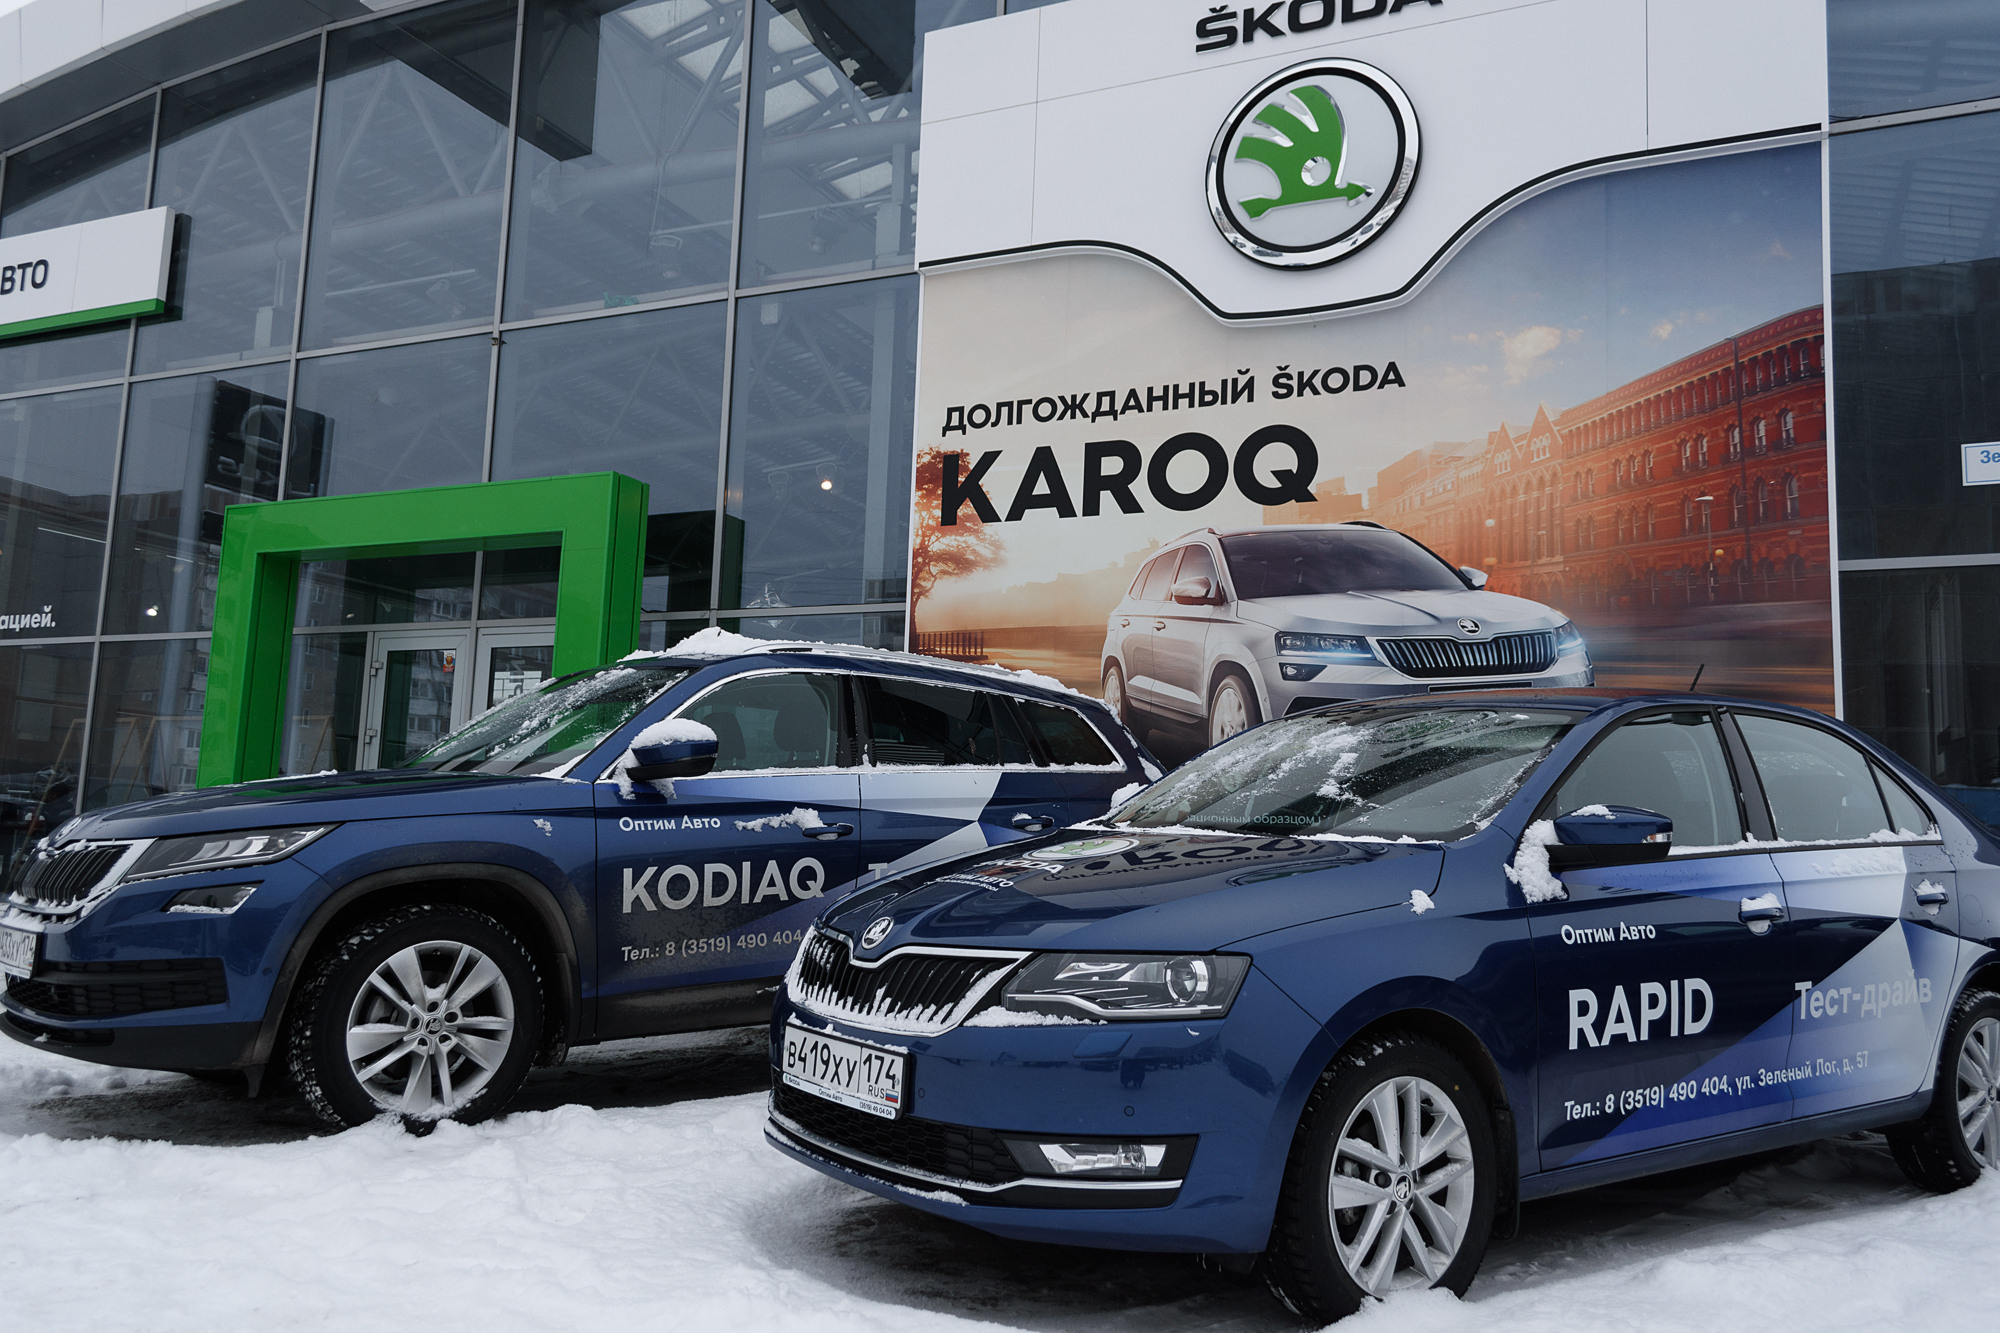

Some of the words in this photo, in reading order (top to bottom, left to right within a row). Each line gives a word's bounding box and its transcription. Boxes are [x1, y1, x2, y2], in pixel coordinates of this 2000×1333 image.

[941, 368, 1256, 437] ДОЛГОЖДАННЫЙ
[1271, 360, 1407, 400] ŠKODA
[940, 424, 1319, 527] KAROQ
[619, 816, 676, 832] Оптим
[681, 815, 721, 829] Авто
[622, 857, 825, 914] KODIAQ
[621, 946, 660, 962] Тел.:
[665, 941, 675, 957] 8
[737, 932, 768, 949] 490
[1561, 924, 1615, 945] Оптим
[1620, 921, 1656, 940] Авто
[1568, 978, 1714, 1050] RAPID
[1794, 969, 1932, 1020] Тест-драйв
[863, 1053, 896, 1090] 174
[868, 1085, 885, 1099] RUS
[1564, 1099, 1600, 1121] Тел.:
[1604, 1093, 1615, 1113] 8
[1669, 1080, 1697, 1101] 490
[1701, 1075, 1732, 1096] 404,
[1735, 1075, 1755, 1095] ул.
[1758, 1060, 1813, 1087] Зеленый
[1816, 1057, 1841, 1077] Лог,
[1842, 1057, 1854, 1074] д.
[1856, 1050, 1869, 1069] 57
